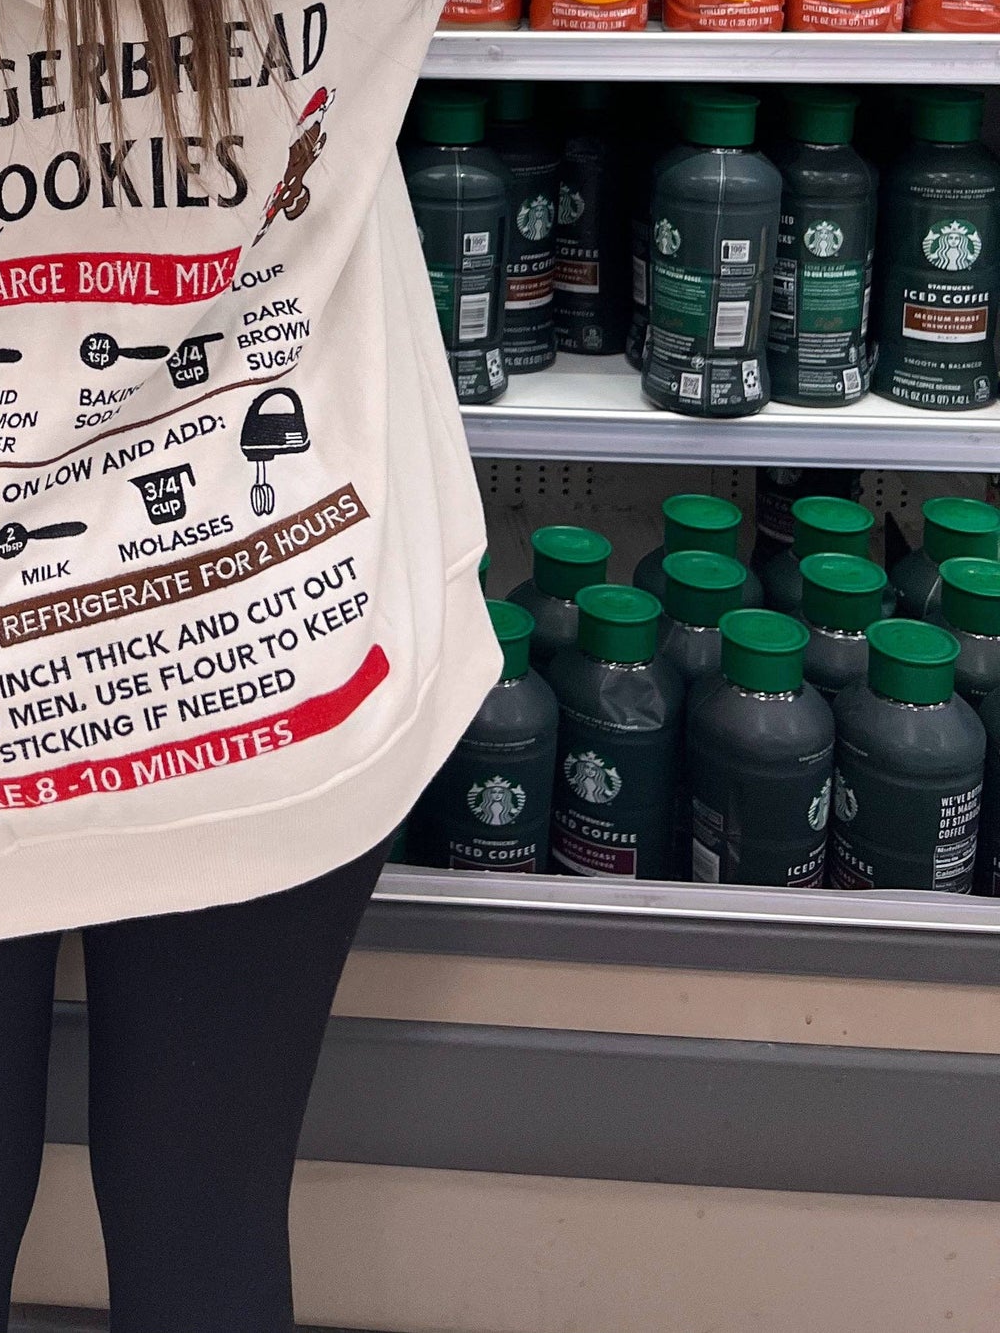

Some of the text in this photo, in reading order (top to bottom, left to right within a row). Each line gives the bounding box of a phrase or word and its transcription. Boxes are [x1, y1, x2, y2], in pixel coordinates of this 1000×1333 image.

[78, 260, 160, 297] BOWL
[231, 263, 285, 292] LOUR
[903, 289, 989, 304] ICED COFFEE
[243, 297, 303, 326] DARK
[914, 311, 980, 322] MEDIUM ROAST
[88, 337, 111, 351] 3/4
[237, 319, 311, 349] BROWN
[88, 350, 109, 365] tsp
[170, 344, 203, 369] 3/4
[246, 345, 304, 371] SUGAR
[903, 356, 982, 369] SMOOTH BALANCED
[175, 365, 204, 381] cup
[79, 378, 146, 407] BAKIN
[2, 477, 39, 503] ON
[45, 456, 93, 491] LOW
[102, 440, 154, 476] AND
[164, 414, 227, 450] ADD:
[145, 477, 180, 502] 3/4
[151, 499, 181, 516] cup
[0, 540, 24, 553] Tbsp
[6, 527, 15, 541] 2
[117, 514, 234, 563] MOLASSES
[2, 494, 359, 641] REFRIGERATE FOR 2 HOURS
[21, 560, 72, 586] MILK
[76, 629, 170, 674] THICK
[177, 610, 240, 652] AND
[247, 586, 299, 624] CUT
[303, 556, 358, 600] OUT
[8, 692, 87, 730] MEN.
[95, 672, 153, 707] USE
[159, 643, 255, 693] FLOUR
[259, 628, 299, 660] TO
[303, 591, 370, 642] KEEP
[0, 714, 134, 764] STICKING
[144, 704, 168, 732] IF
[177, 668, 297, 723] NEEDED
[37, 776, 58, 804] 8
[130, 718, 294, 788] MINUTES
[941, 793, 966, 808] WE'VE
[941, 805, 956, 817] THE
[582, 827, 637, 844] COFFEE
[939, 824, 966, 840] COFFEE
[940, 818, 951, 829] OF
[450, 841, 536, 860] ICED COFFEE
